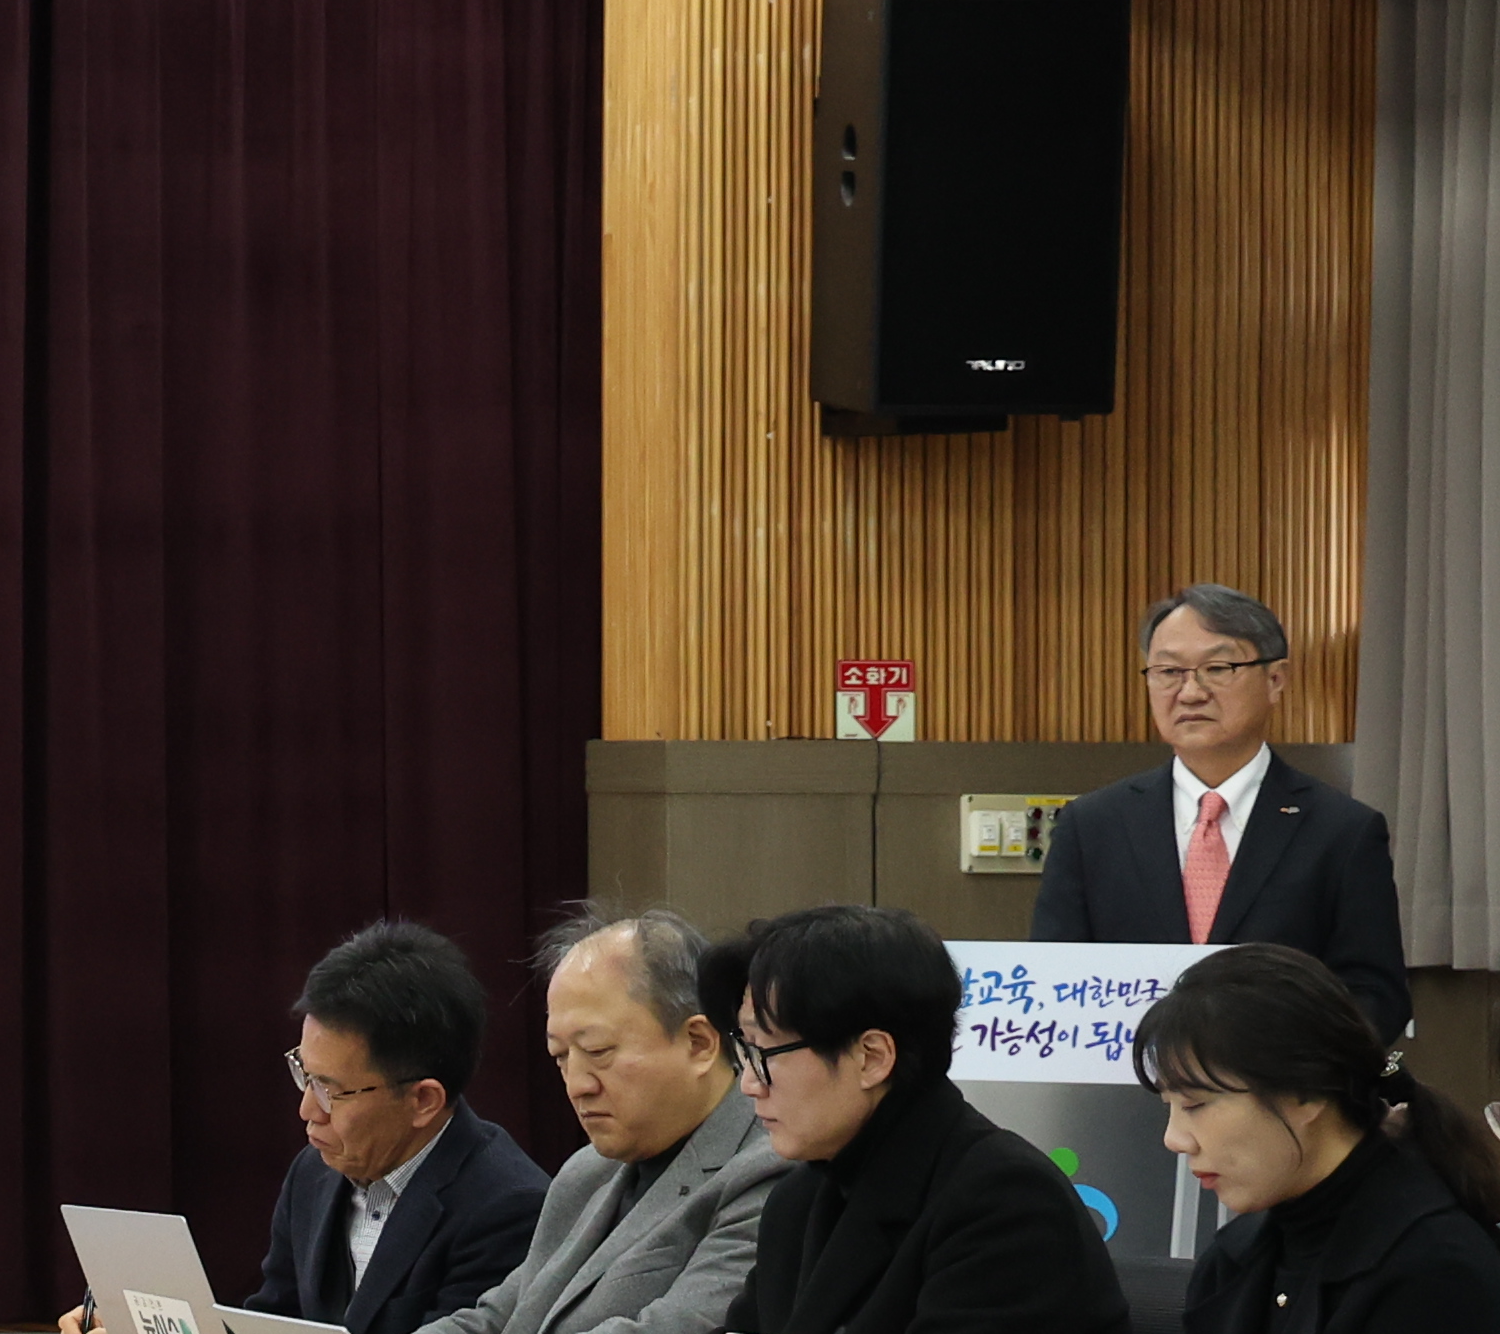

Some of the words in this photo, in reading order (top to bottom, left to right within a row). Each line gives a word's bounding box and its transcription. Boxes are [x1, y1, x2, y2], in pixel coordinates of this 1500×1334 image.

[843, 666, 909, 686] 소화기
[1052, 975, 1168, 1008] 대한민국
[970, 1017, 1079, 1058] 가능성이
